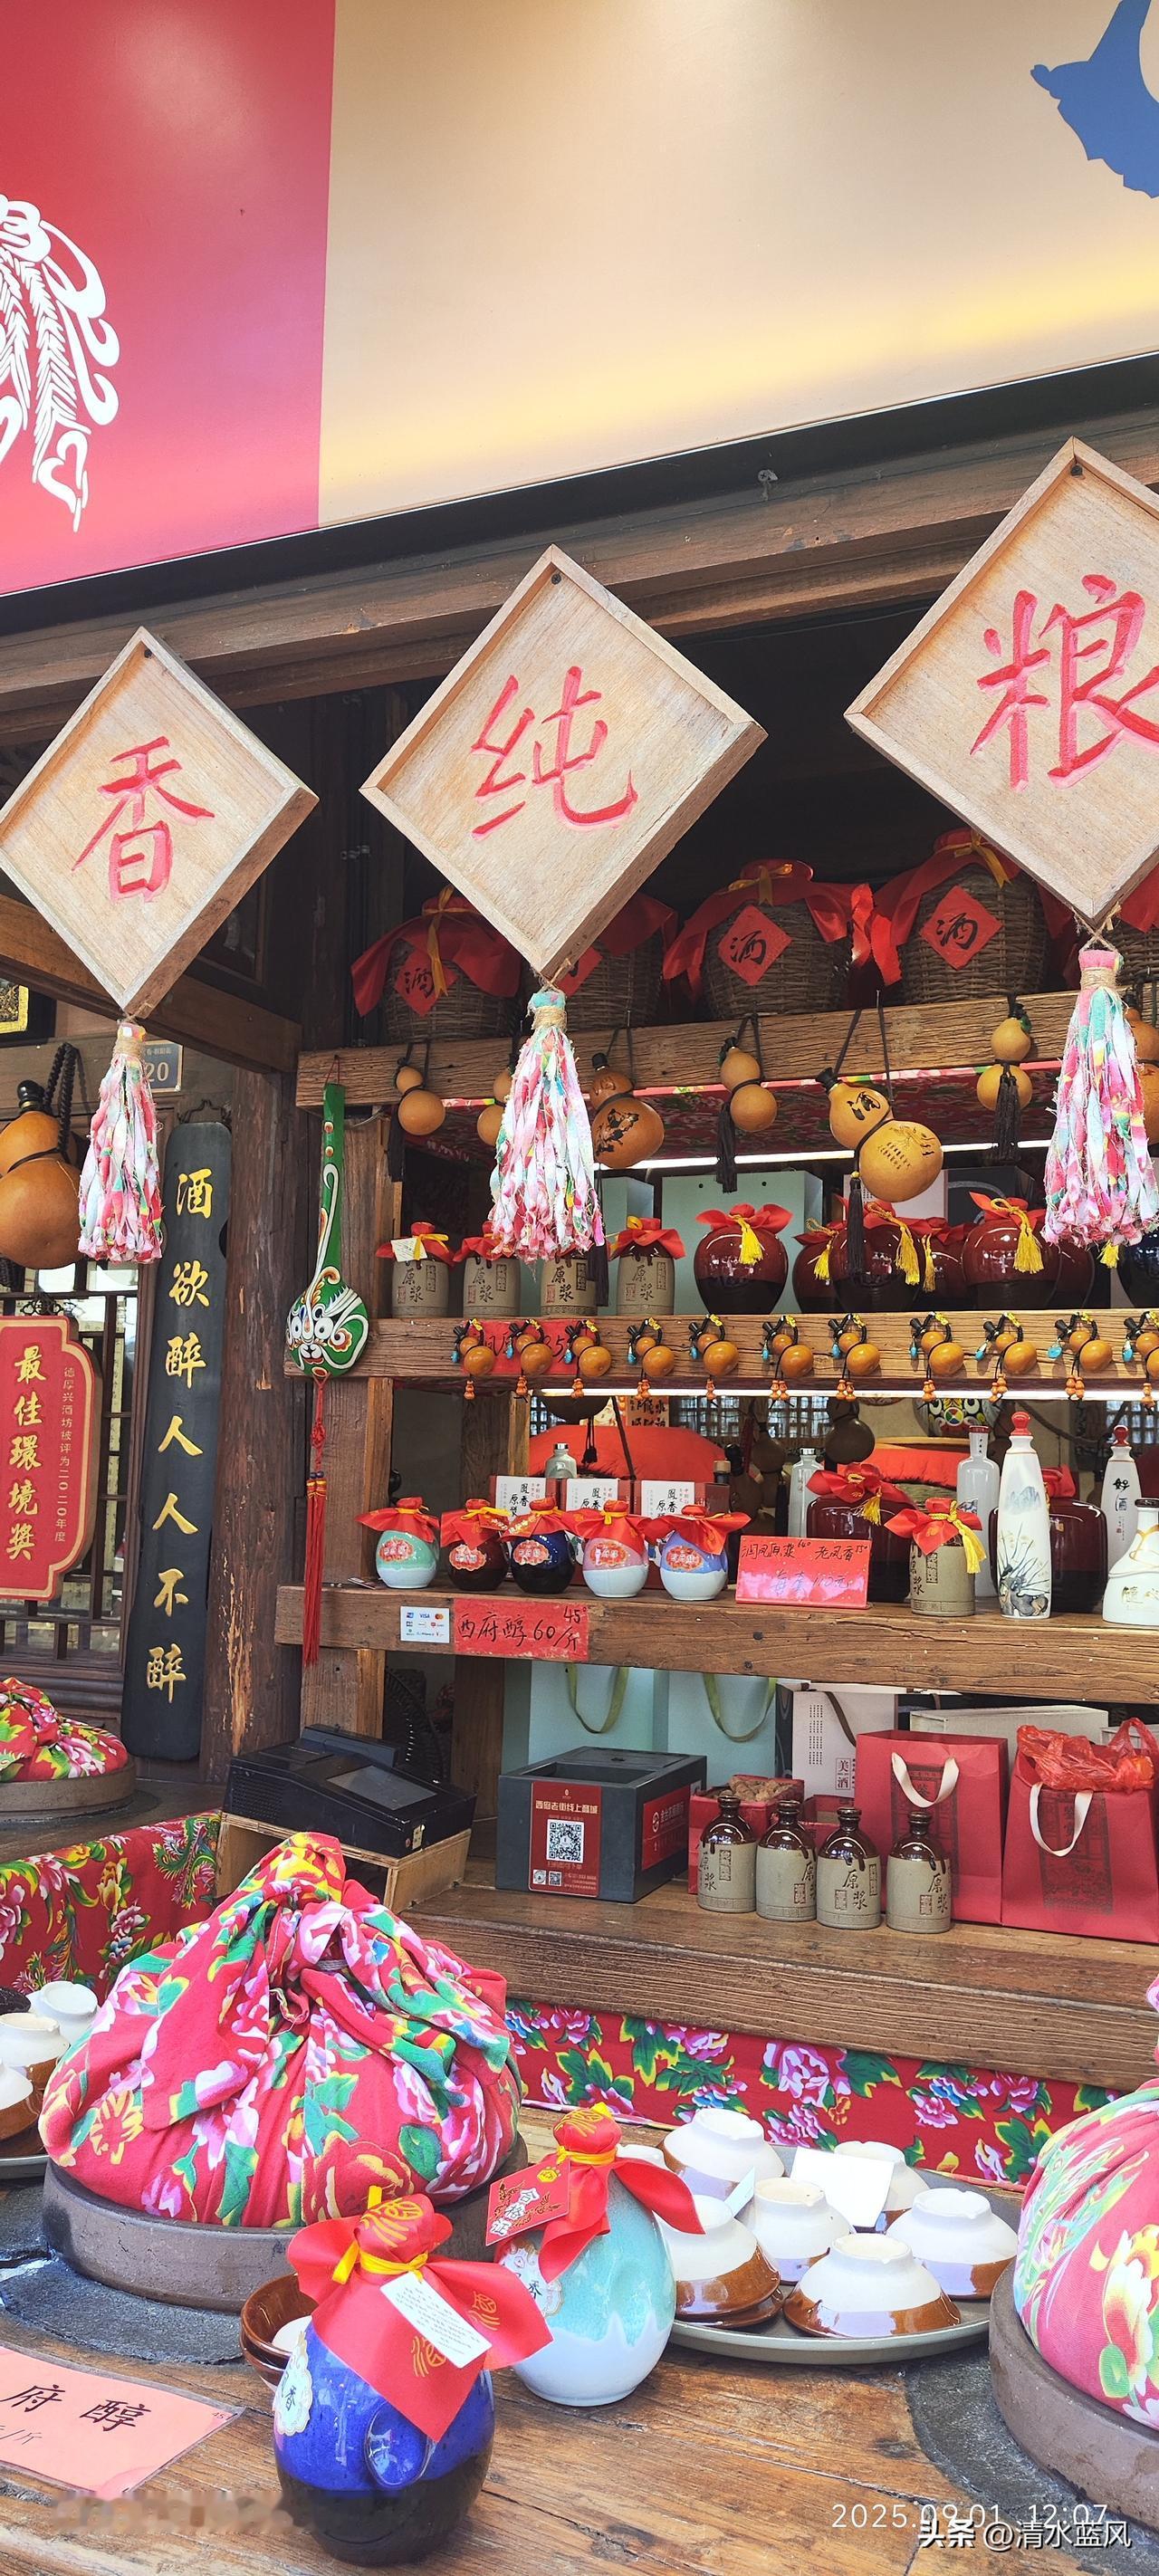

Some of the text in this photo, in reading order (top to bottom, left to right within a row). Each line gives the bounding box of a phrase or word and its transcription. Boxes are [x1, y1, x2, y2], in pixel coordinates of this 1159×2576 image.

[970, 574, 1159, 792] 粮
[471, 666, 638, 840] 纯
[71, 735, 216, 904] 香
[730, 934, 767, 965] 酒
[936, 911, 979, 949] 酒
[404, 967, 435, 999] 酒
[551, 1265, 574, 1302] 原浆
[147, 1168, 213, 1704] 酒欲醉人人不醉
[457, 1612, 528, 1647] 西府醇
[837, 1759, 849, 1788] 美酒
[842, 1869, 868, 1910] 原浆
[928, 1872, 948, 1914] 原浆
[491, 2188, 540, 2236] 合格证
[2, 2384, 151, 2432] 府醇
